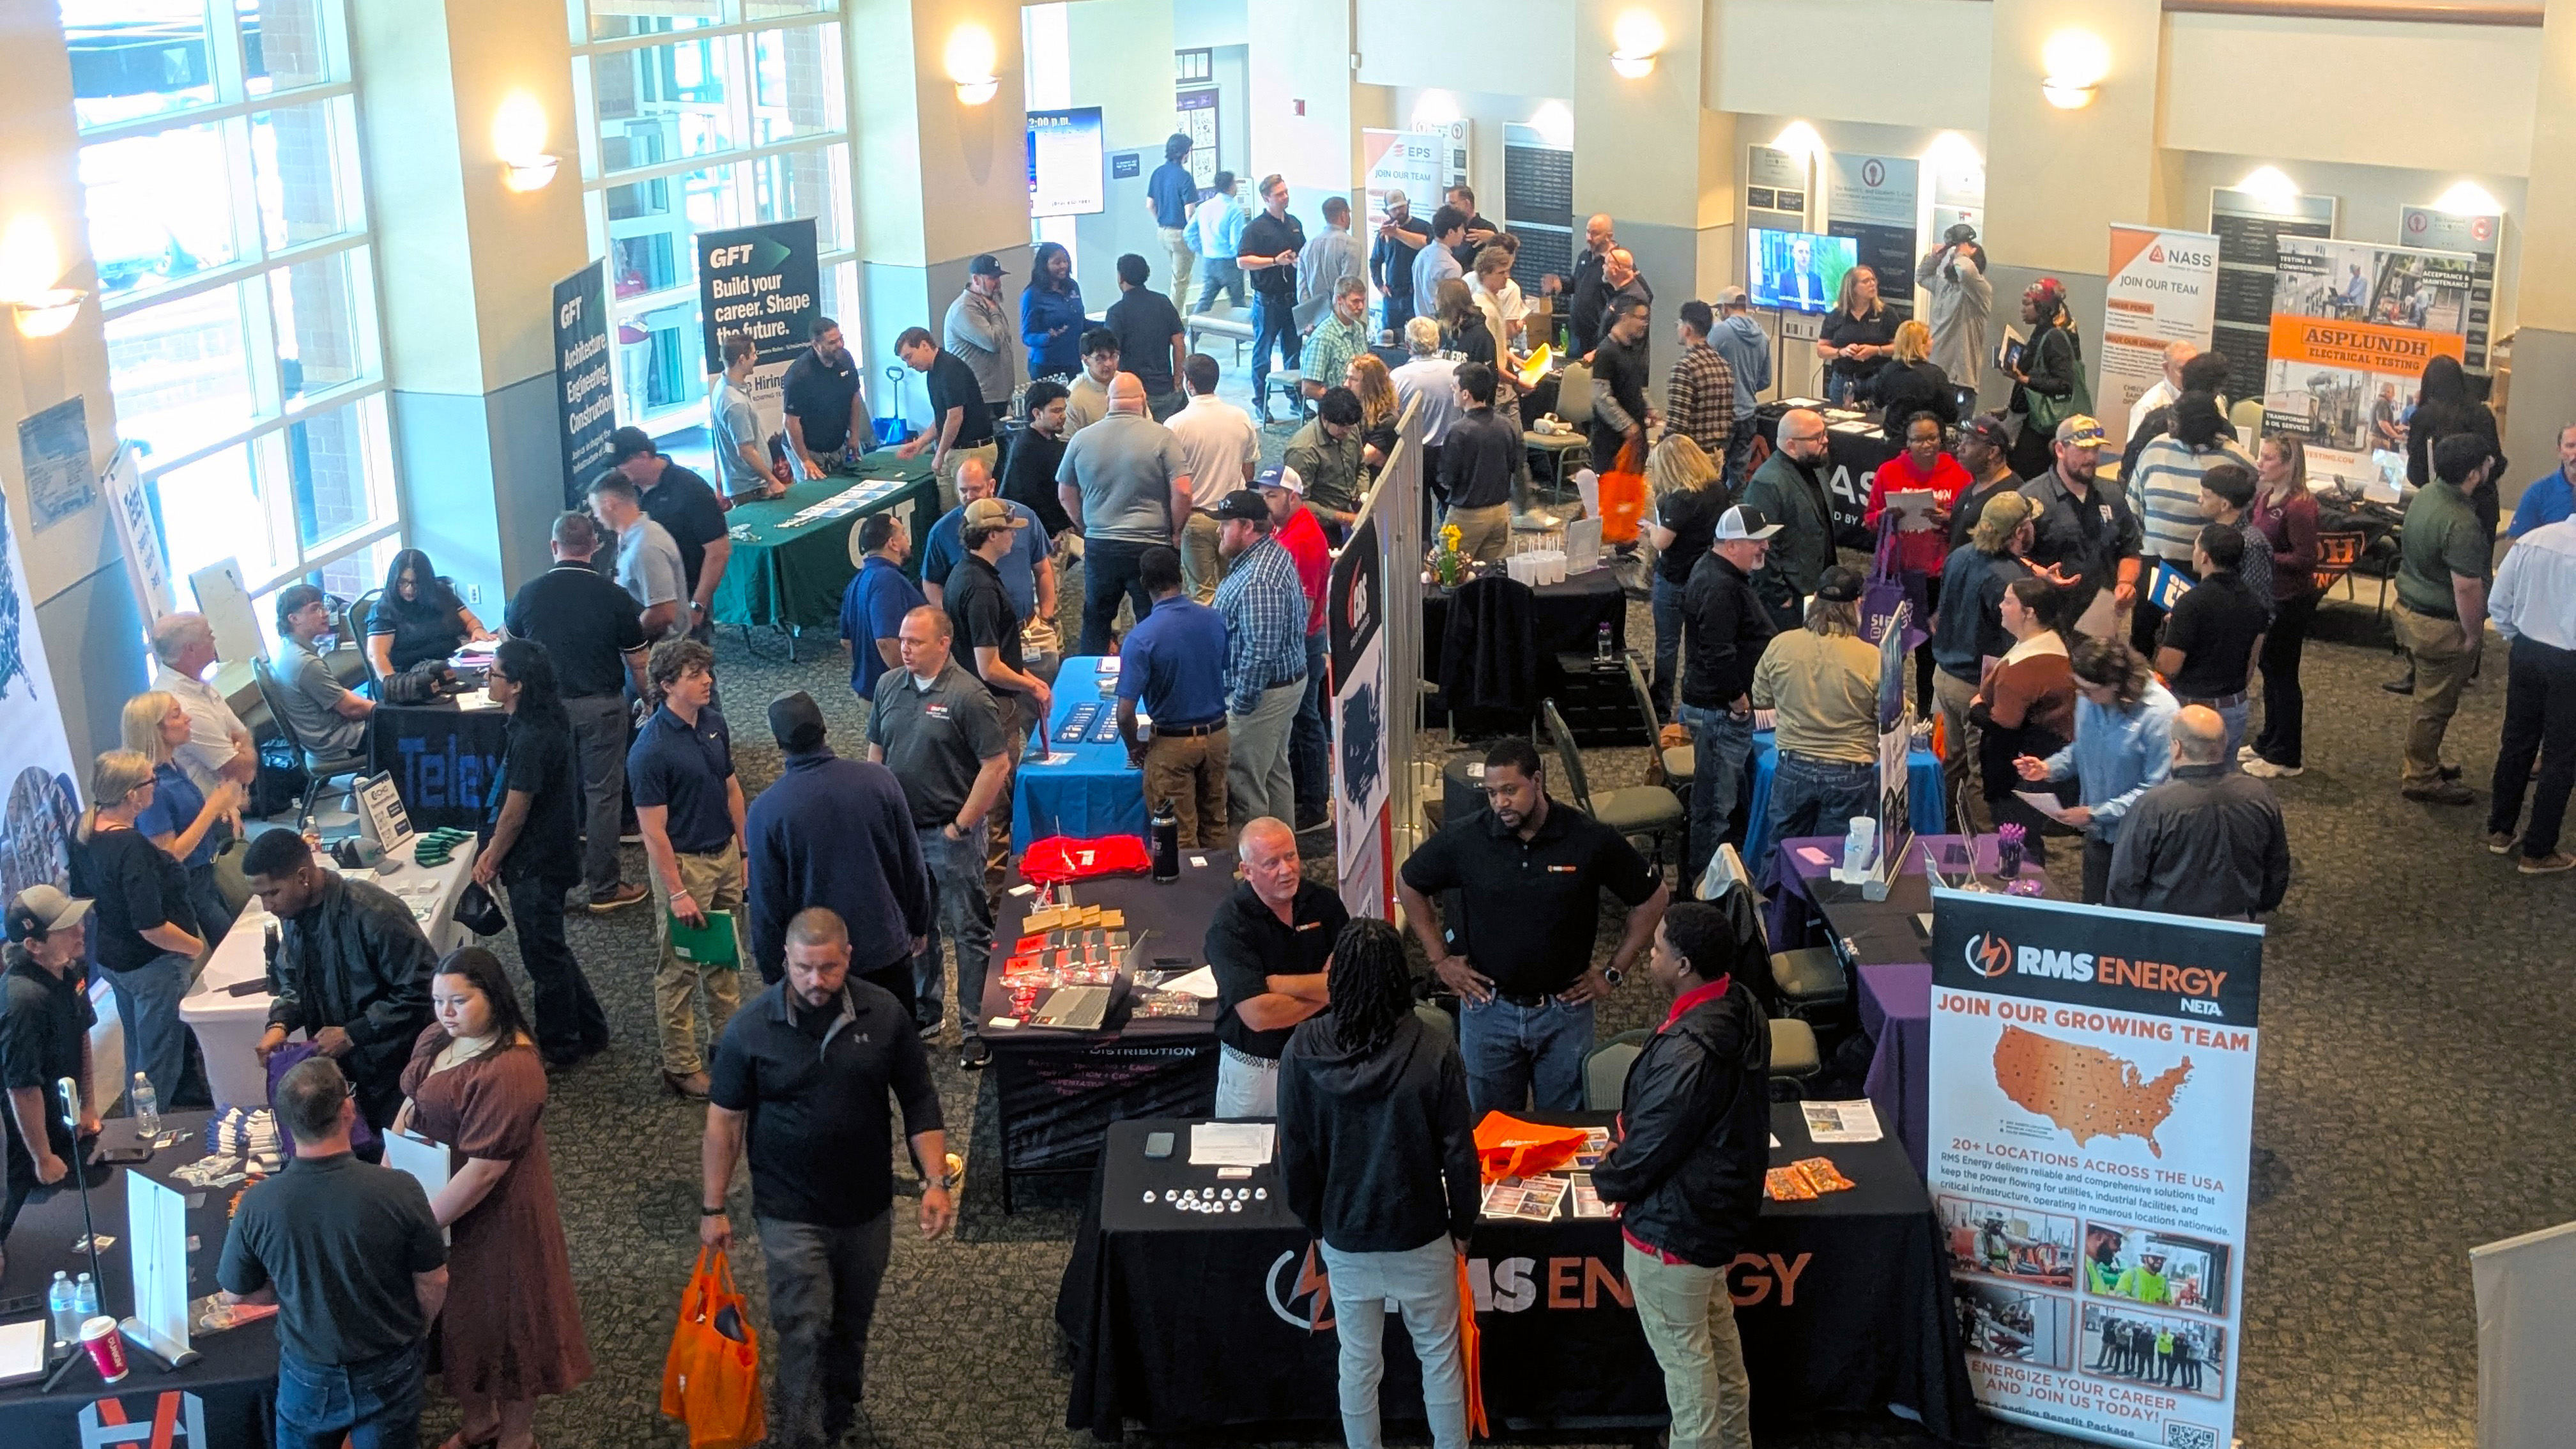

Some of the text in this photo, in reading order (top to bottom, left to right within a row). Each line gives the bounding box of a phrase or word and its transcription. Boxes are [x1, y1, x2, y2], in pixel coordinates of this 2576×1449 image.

[1408, 147, 1430, 158] EPS
[1375, 169, 1430, 181] JOIN OUR TEAM
[710, 244, 753, 268] GFT
[2168, 250, 2212, 267] NASS
[713, 274, 782, 298] Build your
[2119, 275, 2198, 295] JOIN OUR TEAM
[2422, 278, 2469, 288] MAINTENANCE
[2423, 270, 2463, 280] ACCEPTANCE
[560, 296, 583, 329] GFT
[715, 293, 810, 322] career. Shape
[743, 321, 790, 341] future.
[2305, 329, 2427, 356] ASPLUNDH
[2309, 348, 2419, 370] ELECTRICAL TESTING
[569, 394, 614, 434] Construction
[2266, 413, 2310, 424] TRANSFORMER
[2281, 422, 2310, 432] SERVICES
[1844, 514, 1858, 525] BY
[2018, 946, 2228, 998] RMS ENERGY
[2181, 999, 2224, 1016] NETA
[1937, 993, 2250, 1052] JOIN OUR GROWING TEAM
[1952, 1138, 2225, 1192] 20+ LOCATIONS ACROSS THE USA
[1940, 1165, 2198, 1215] keep the power flowing for utilities, industrial facilities, and
[1941, 1152, 2215, 1205] RMS Energy delivers reliable and comprehensive solutions that
[1940, 1180, 2230, 1236] critical infrastructure, operating in numerous locations nationwide.
[1548, 1252, 1813, 1308] ENGY
[1971, 1360, 2176, 1411] ENERGIZE YOUR CAREER
[1986, 1378, 2159, 1423] AND JOIN US TODAY!
[2043, 1411, 2083, 1427] Benefit
[2086, 1420, 2135, 1438] Package
